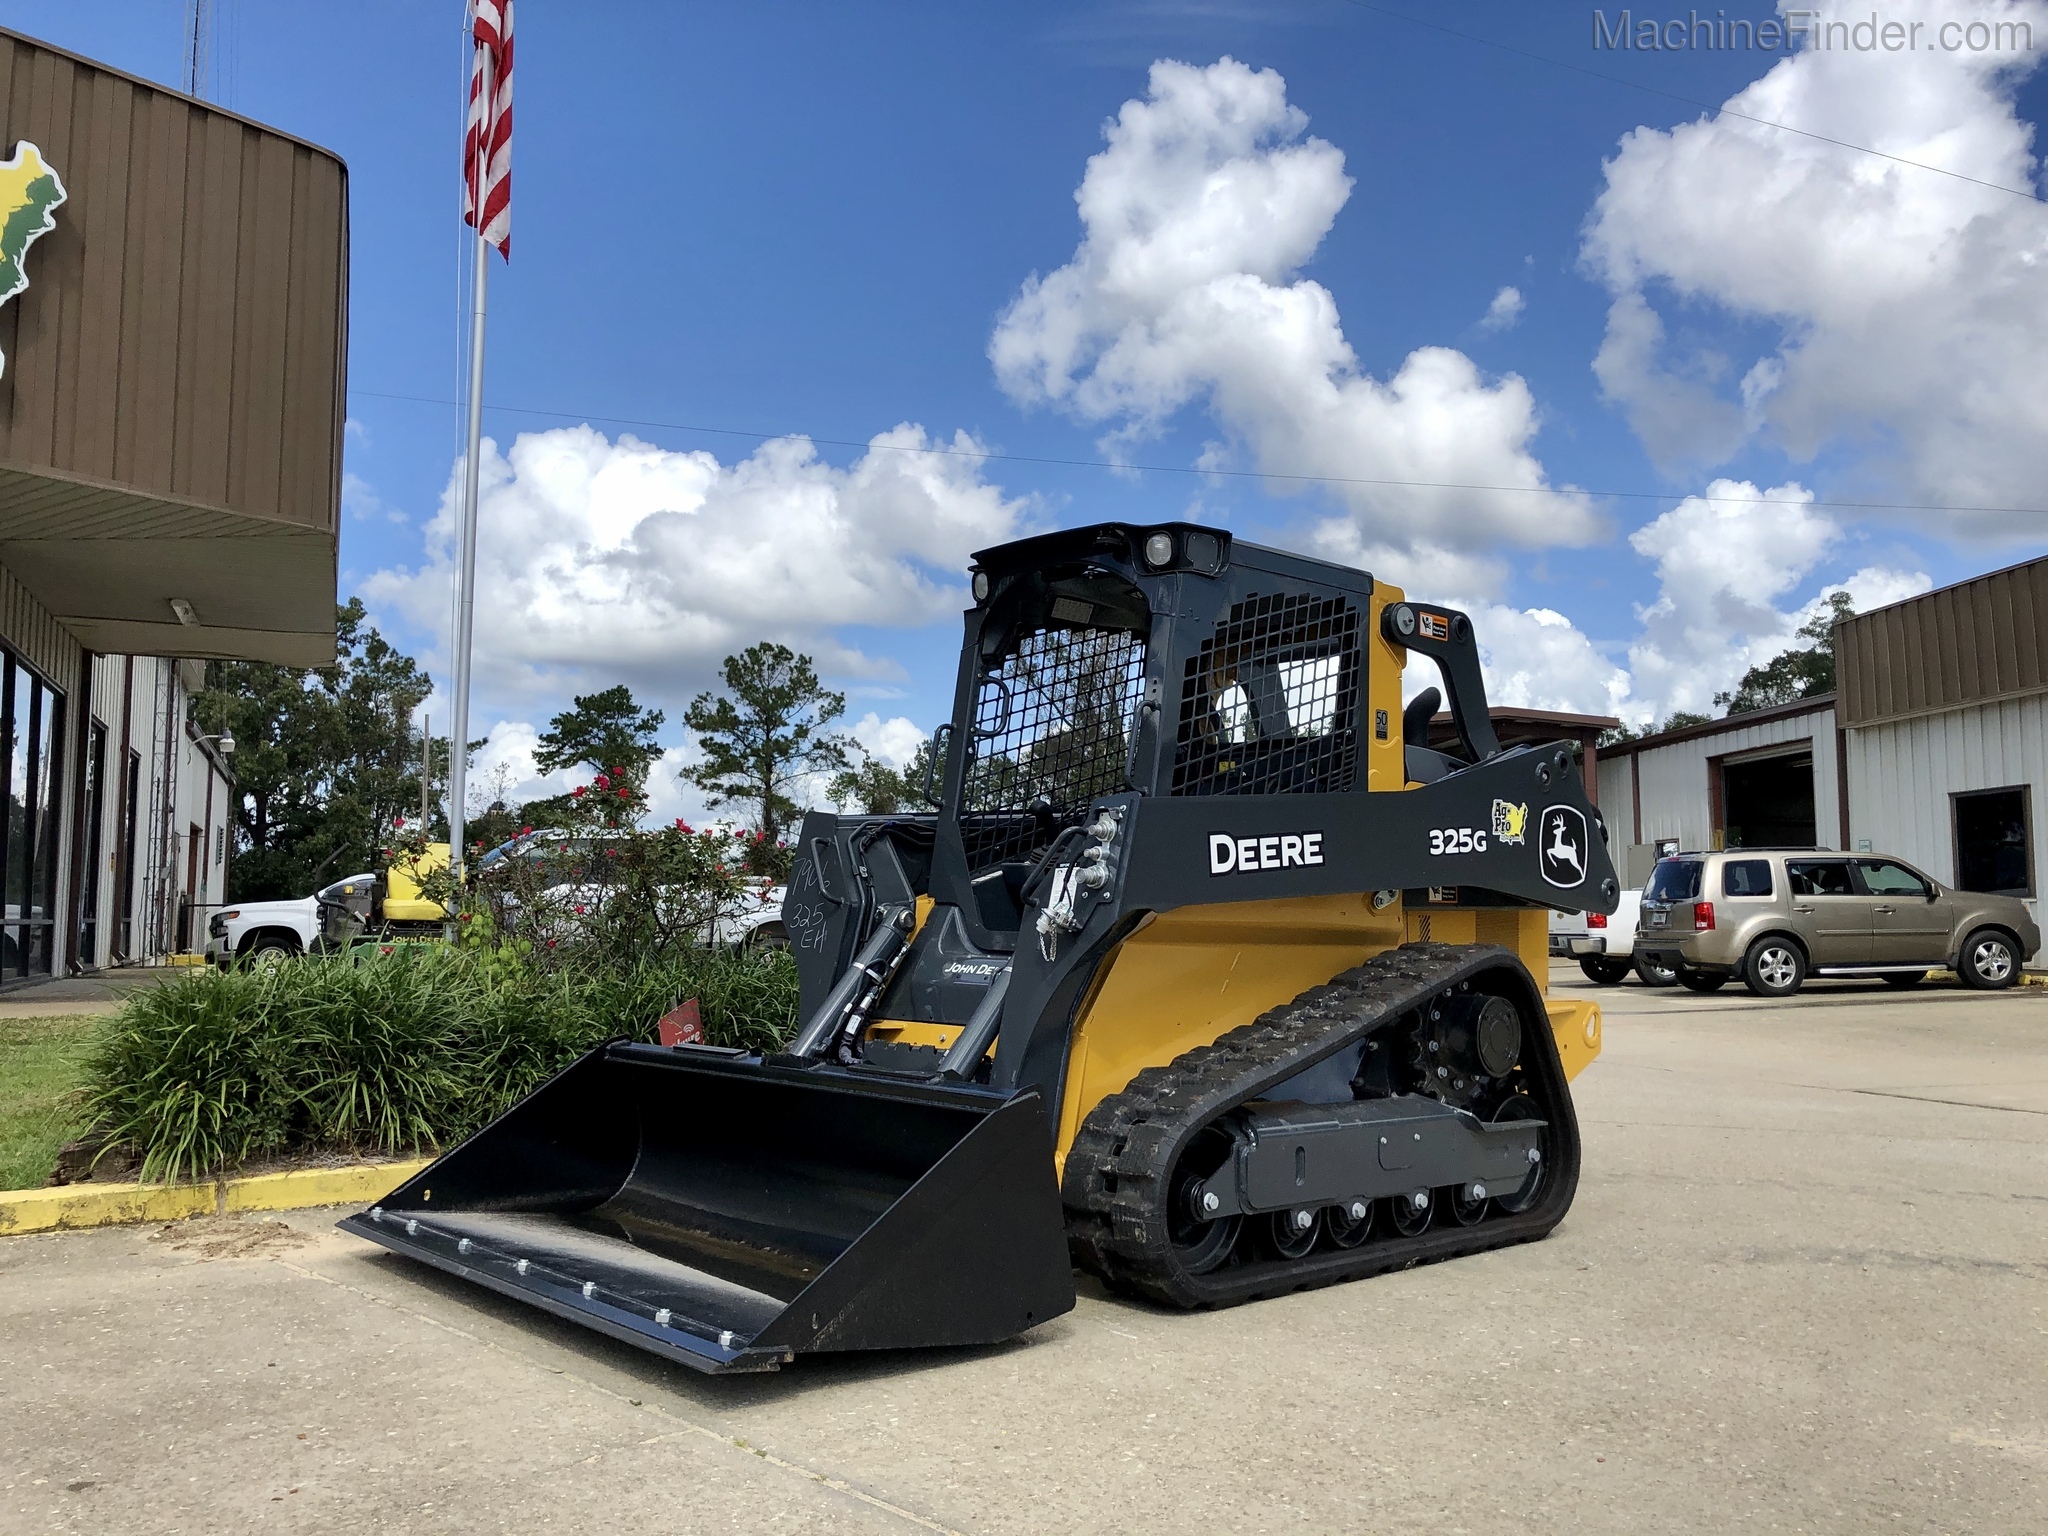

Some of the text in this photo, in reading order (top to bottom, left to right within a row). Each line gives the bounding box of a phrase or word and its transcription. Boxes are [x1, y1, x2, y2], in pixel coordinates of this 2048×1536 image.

[1376, 711, 1387, 725] 50
[1494, 817, 1511, 832] Pro
[1429, 828, 1487, 855] 325G
[1208, 833, 1324, 875] DEERE
[789, 903, 825, 929] 325
[389, 935, 417, 944] JOHN
[944, 962, 978, 975] JOHN
